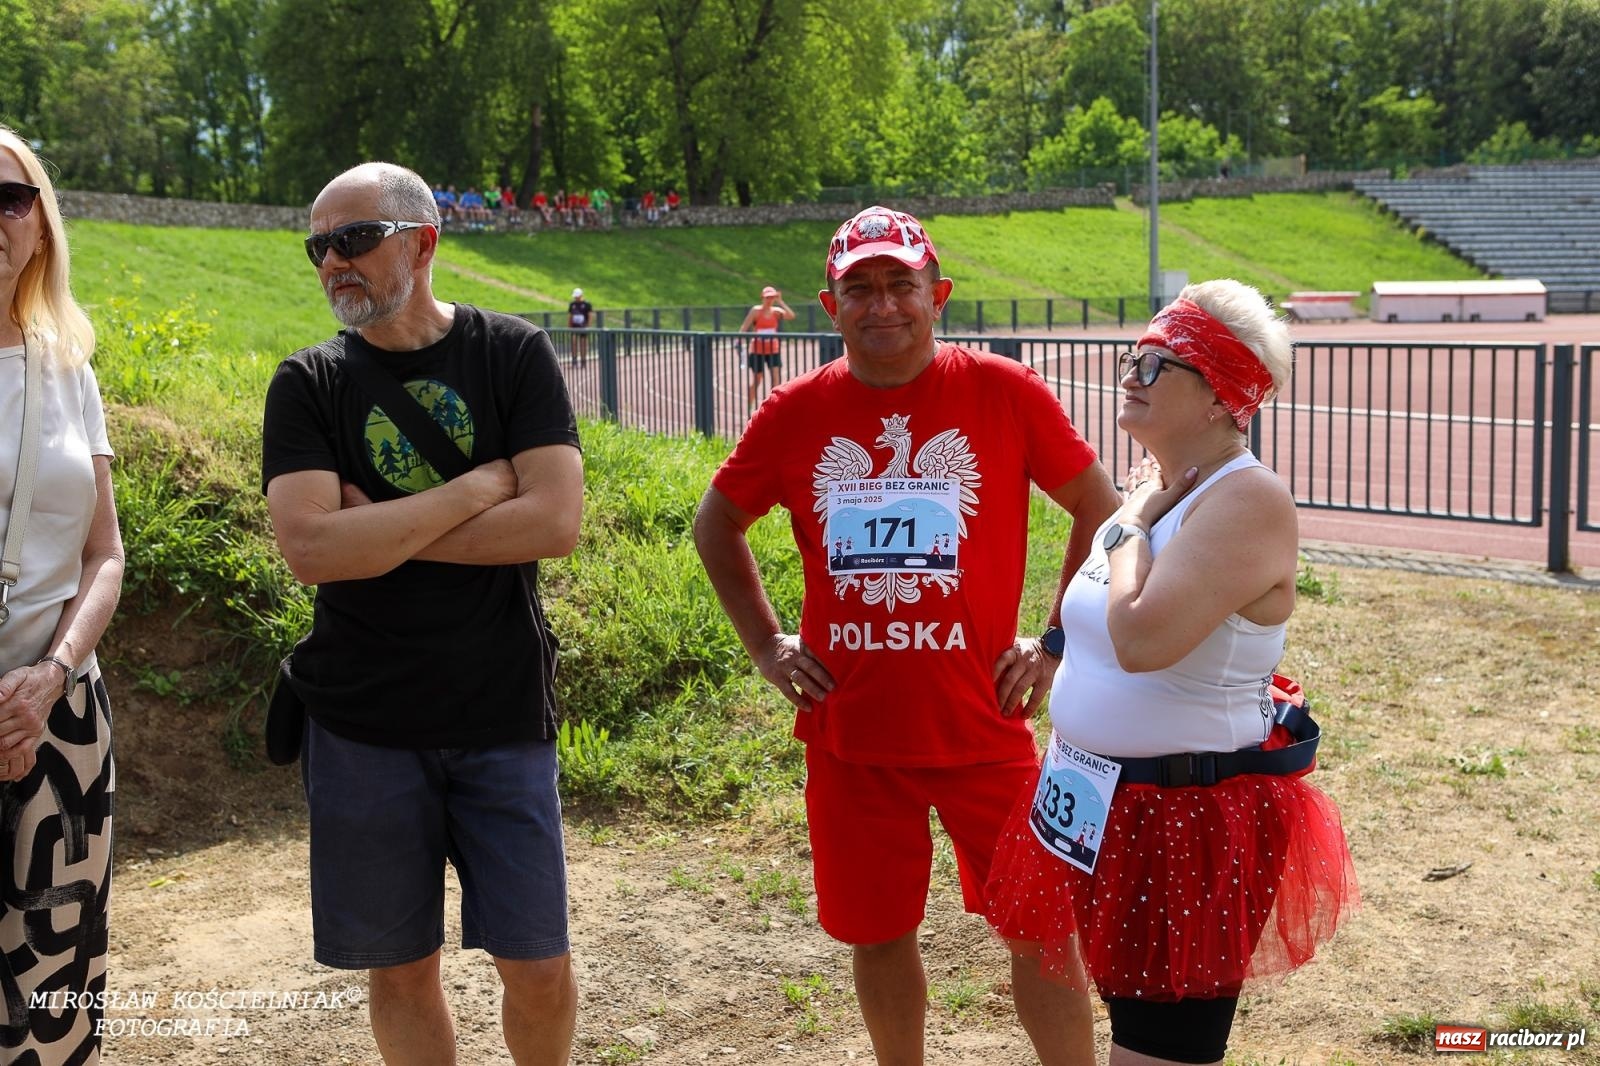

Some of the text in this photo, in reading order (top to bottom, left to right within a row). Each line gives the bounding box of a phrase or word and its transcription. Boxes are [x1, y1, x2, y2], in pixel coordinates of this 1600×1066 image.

[838, 481, 950, 493] XVII BIEG BEZ GRANIC
[843, 497, 862, 506] maja
[864, 517, 916, 548] 171
[829, 621, 967, 651] POLSKA
[1061, 741, 1073, 758] BEZ
[1073, 750, 1111, 774] GRANIC
[1042, 775, 1076, 828] 233
